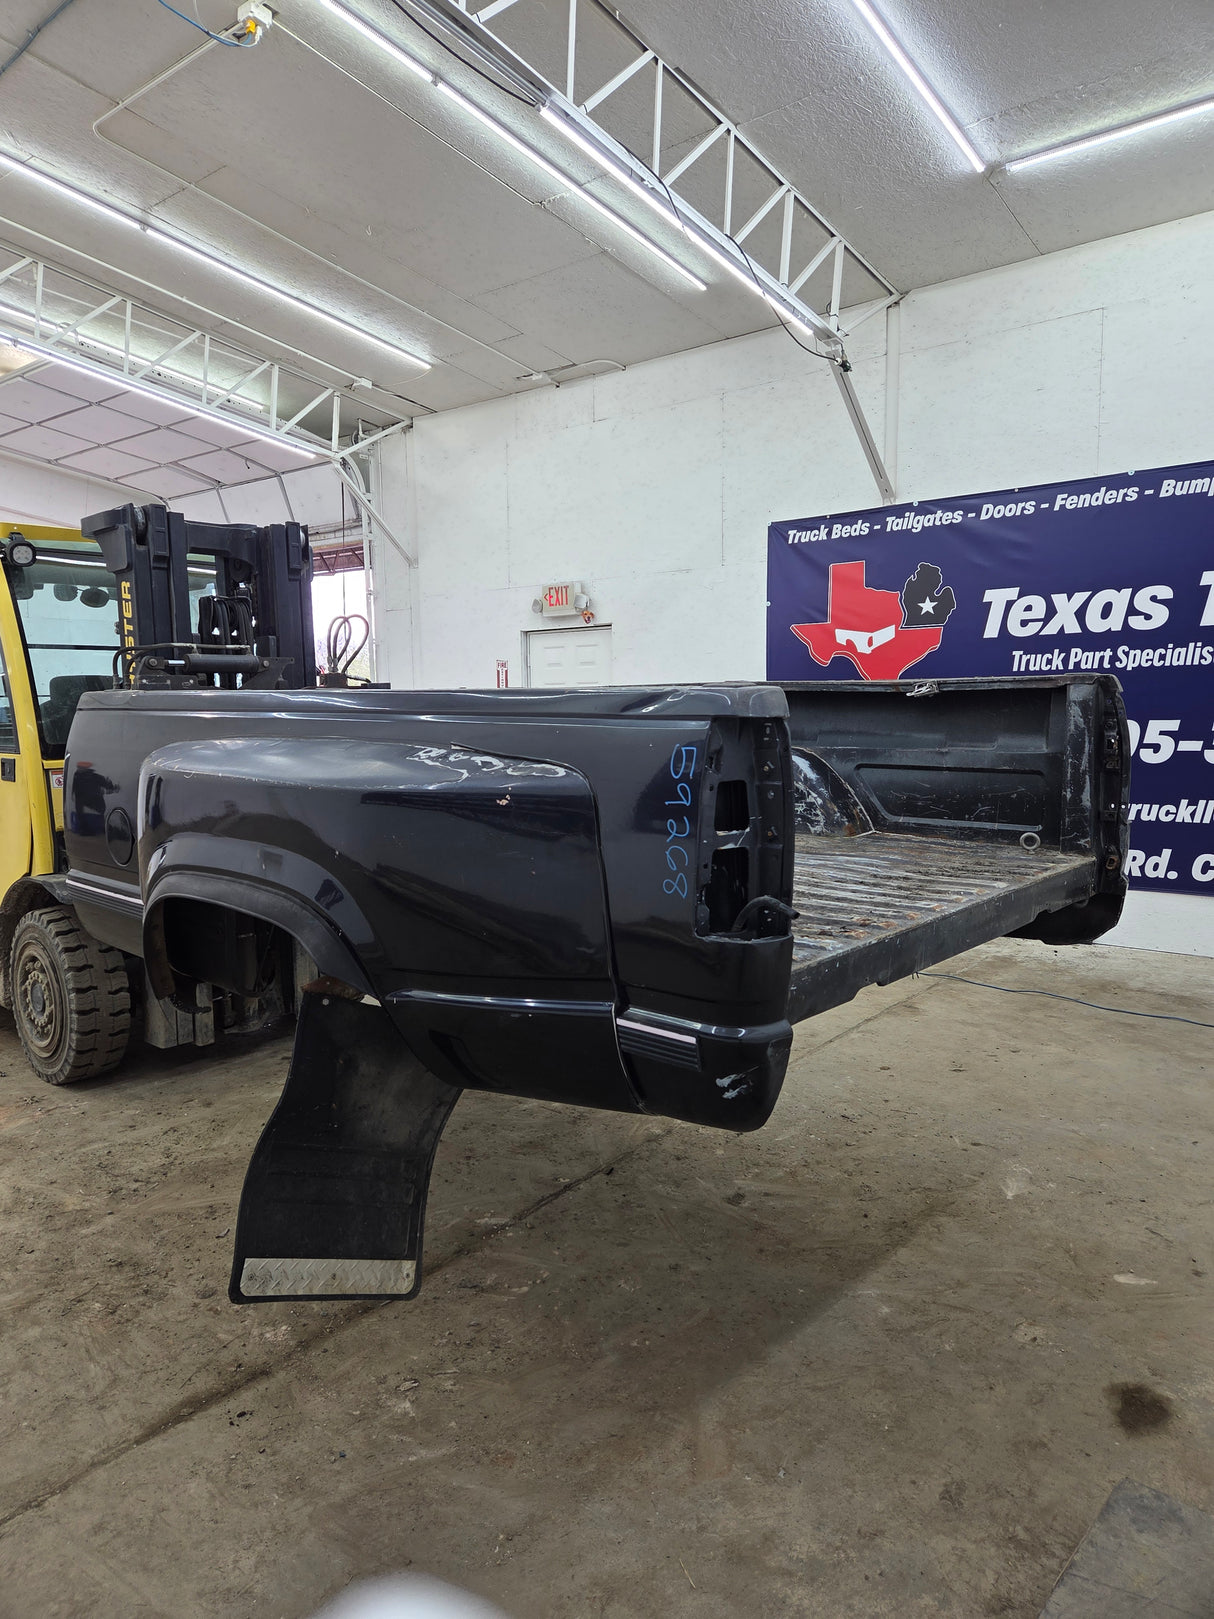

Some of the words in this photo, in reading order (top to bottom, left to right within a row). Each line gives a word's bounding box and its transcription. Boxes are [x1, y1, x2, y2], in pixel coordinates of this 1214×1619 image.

[787, 525, 829, 545] Truck
[831, 520, 870, 540] Beds
[885, 510, 963, 533] Tailgates
[967, 511, 976, 519] -
[980, 500, 1036, 521] Doors
[1040, 502, 1049, 510] -
[1053, 486, 1140, 512] Fenders
[1144, 488, 1154, 496] -
[548, 585, 569, 607] EXIT
[982, 584, 1174, 639] Texas
[1012, 648, 1066, 672] Truck
[1068, 648, 1113, 670] Part
[1115, 641, 1214, 671] Specialis
[1124, 848, 1178, 880] Rd.
